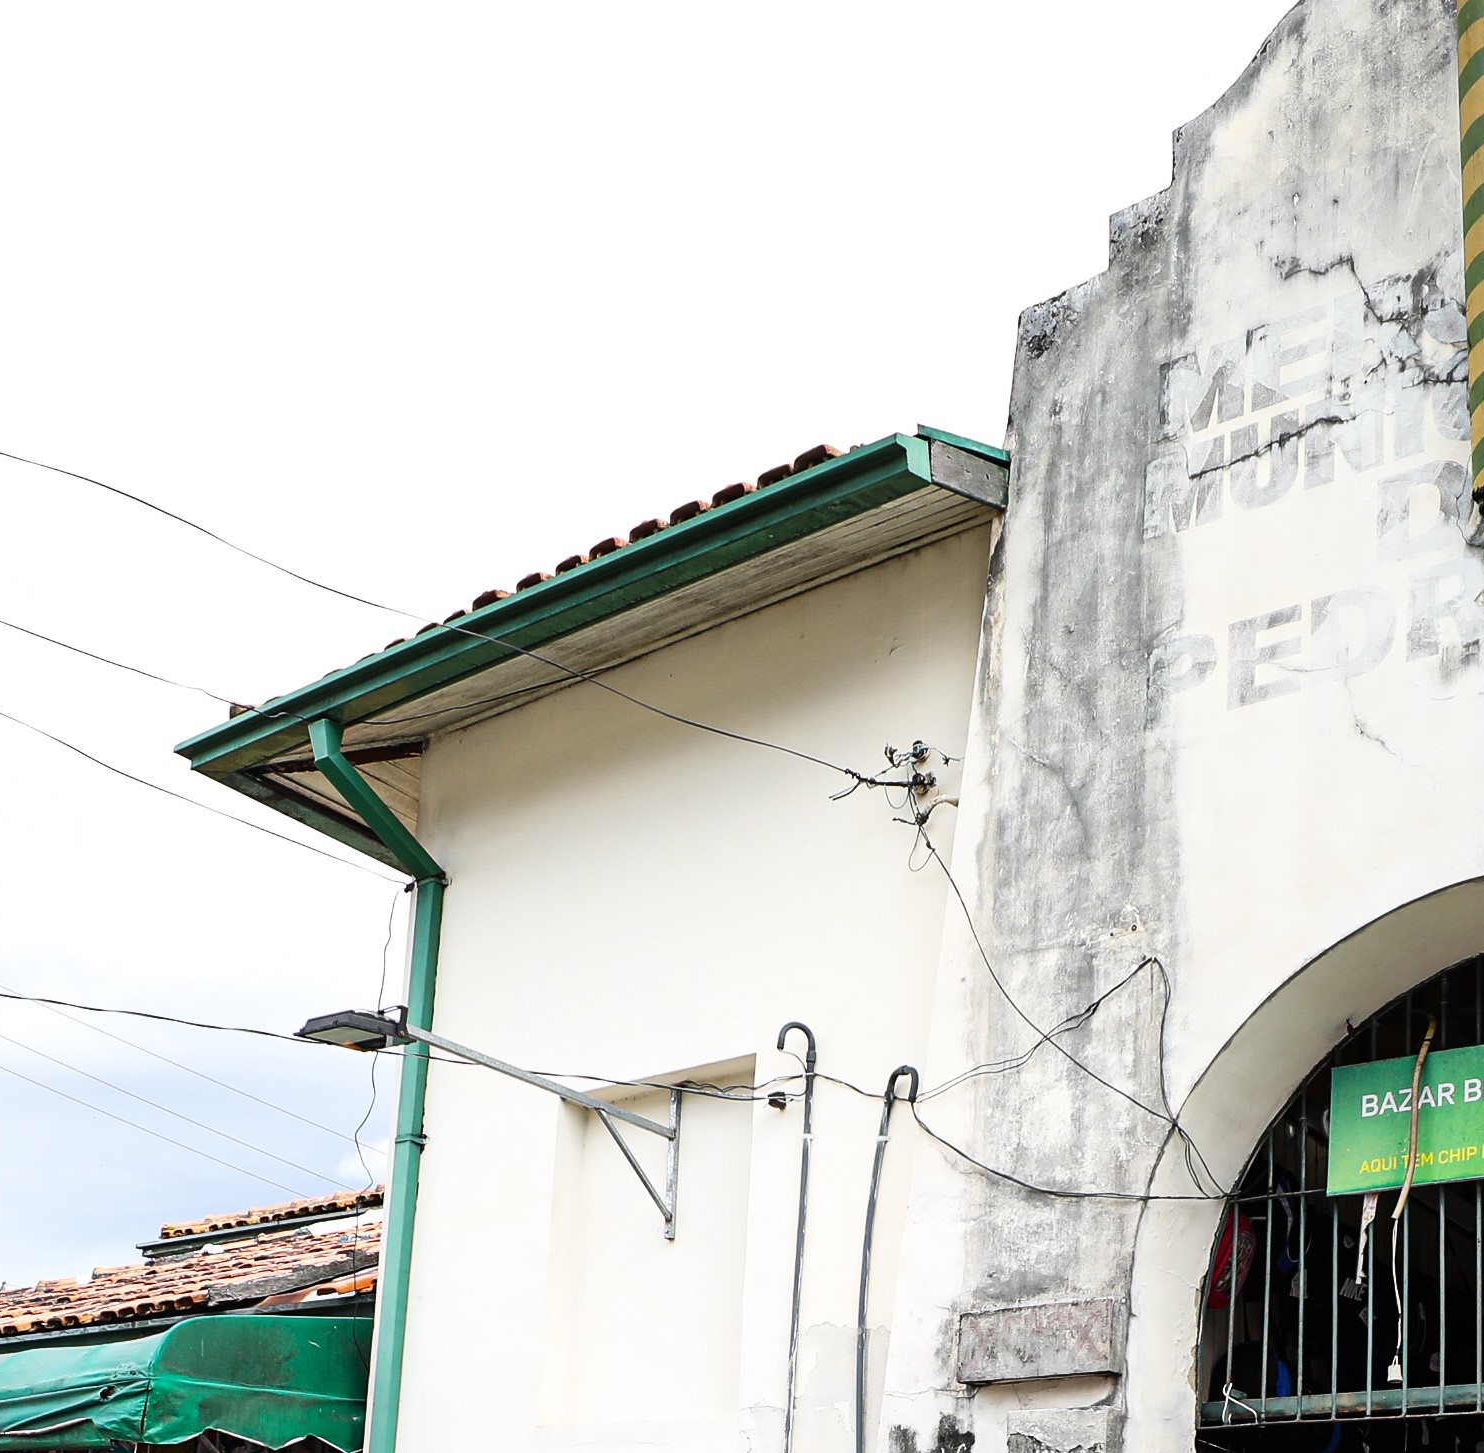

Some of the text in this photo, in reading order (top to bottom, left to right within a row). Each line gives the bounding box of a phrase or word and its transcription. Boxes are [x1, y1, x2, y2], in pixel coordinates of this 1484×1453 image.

[1360, 1082, 1456, 1118] BAZAR
[1359, 1154, 1398, 1174] AQUI
[1437, 1145, 1478, 1166] CHIP
